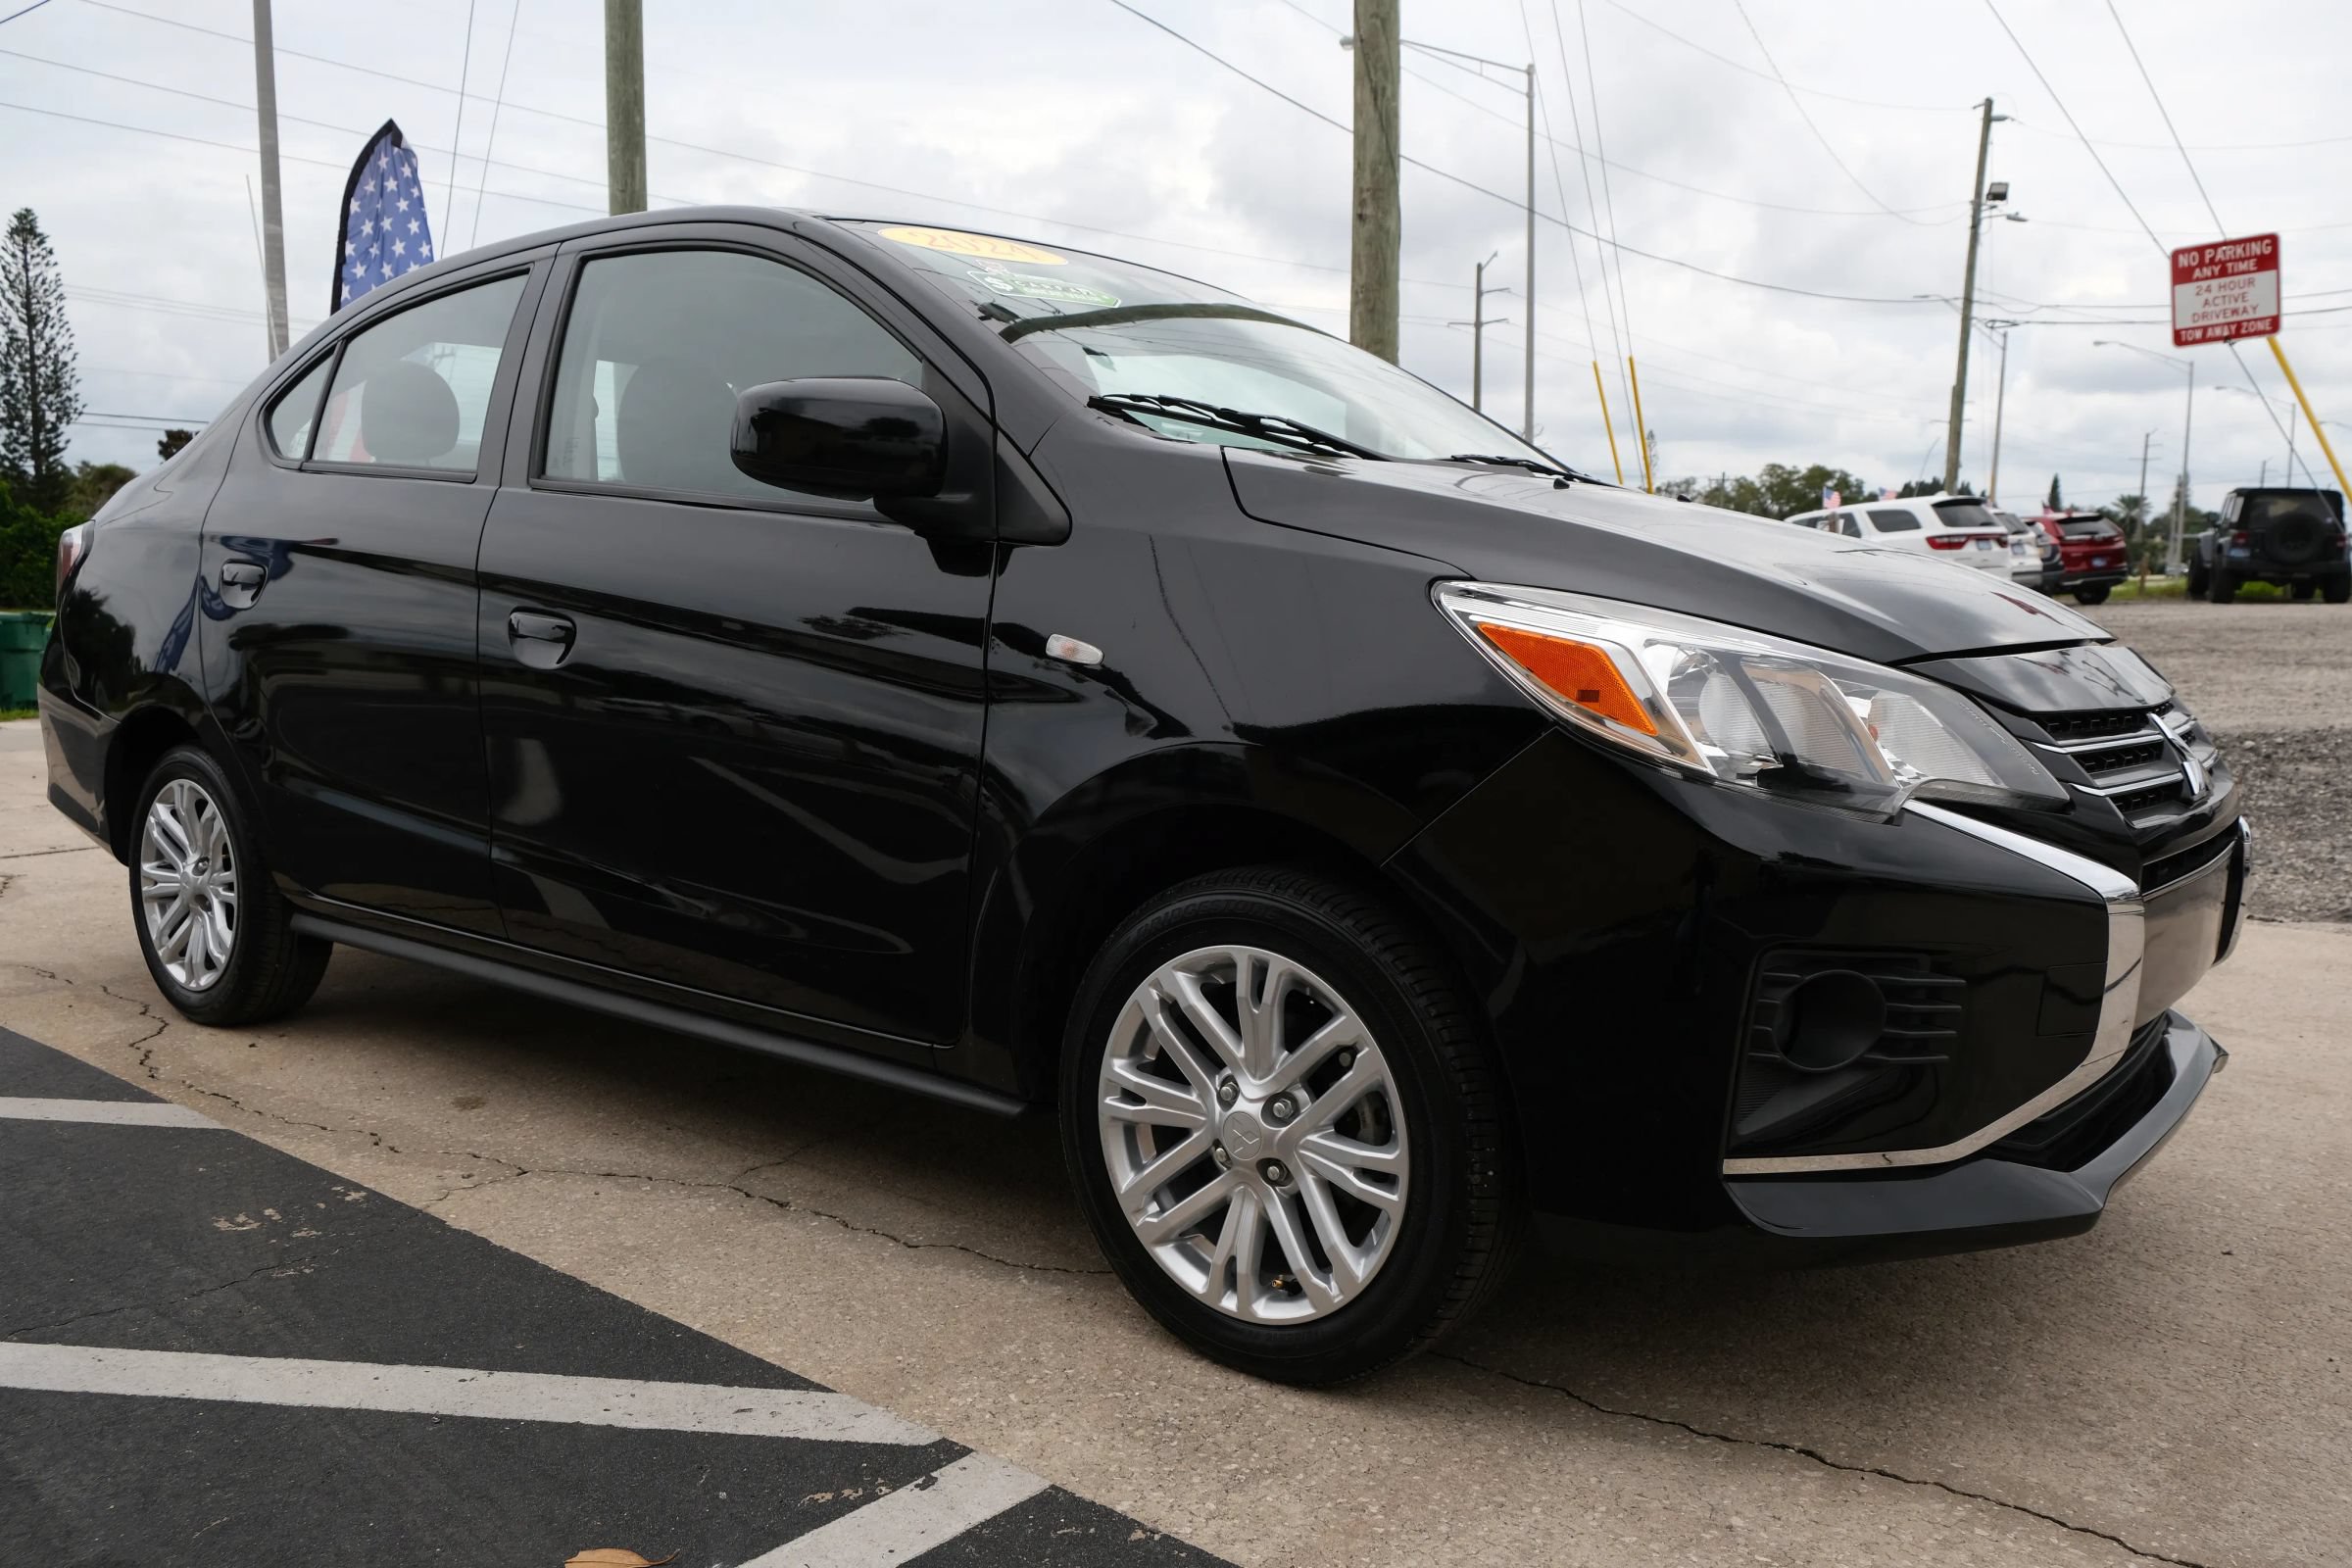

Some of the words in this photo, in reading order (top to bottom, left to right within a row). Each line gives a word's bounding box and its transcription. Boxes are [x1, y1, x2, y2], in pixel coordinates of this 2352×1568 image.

[2178, 251, 2200, 268] NO
[2204, 239, 2273, 265] PARKING
[2192, 264, 2222, 280] ANY
[2226, 258, 2258, 274] TIME
[2195, 284, 2212, 297] 24
[2219, 276, 2256, 292] HOUR
[2202, 292, 2249, 308] ACTIVE
[2191, 304, 2259, 323] DRIVEWAY
[2180, 328, 2204, 342] TOW
[2206, 322, 2238, 339] AWAY
[2240, 318, 2273, 333] ZONE
